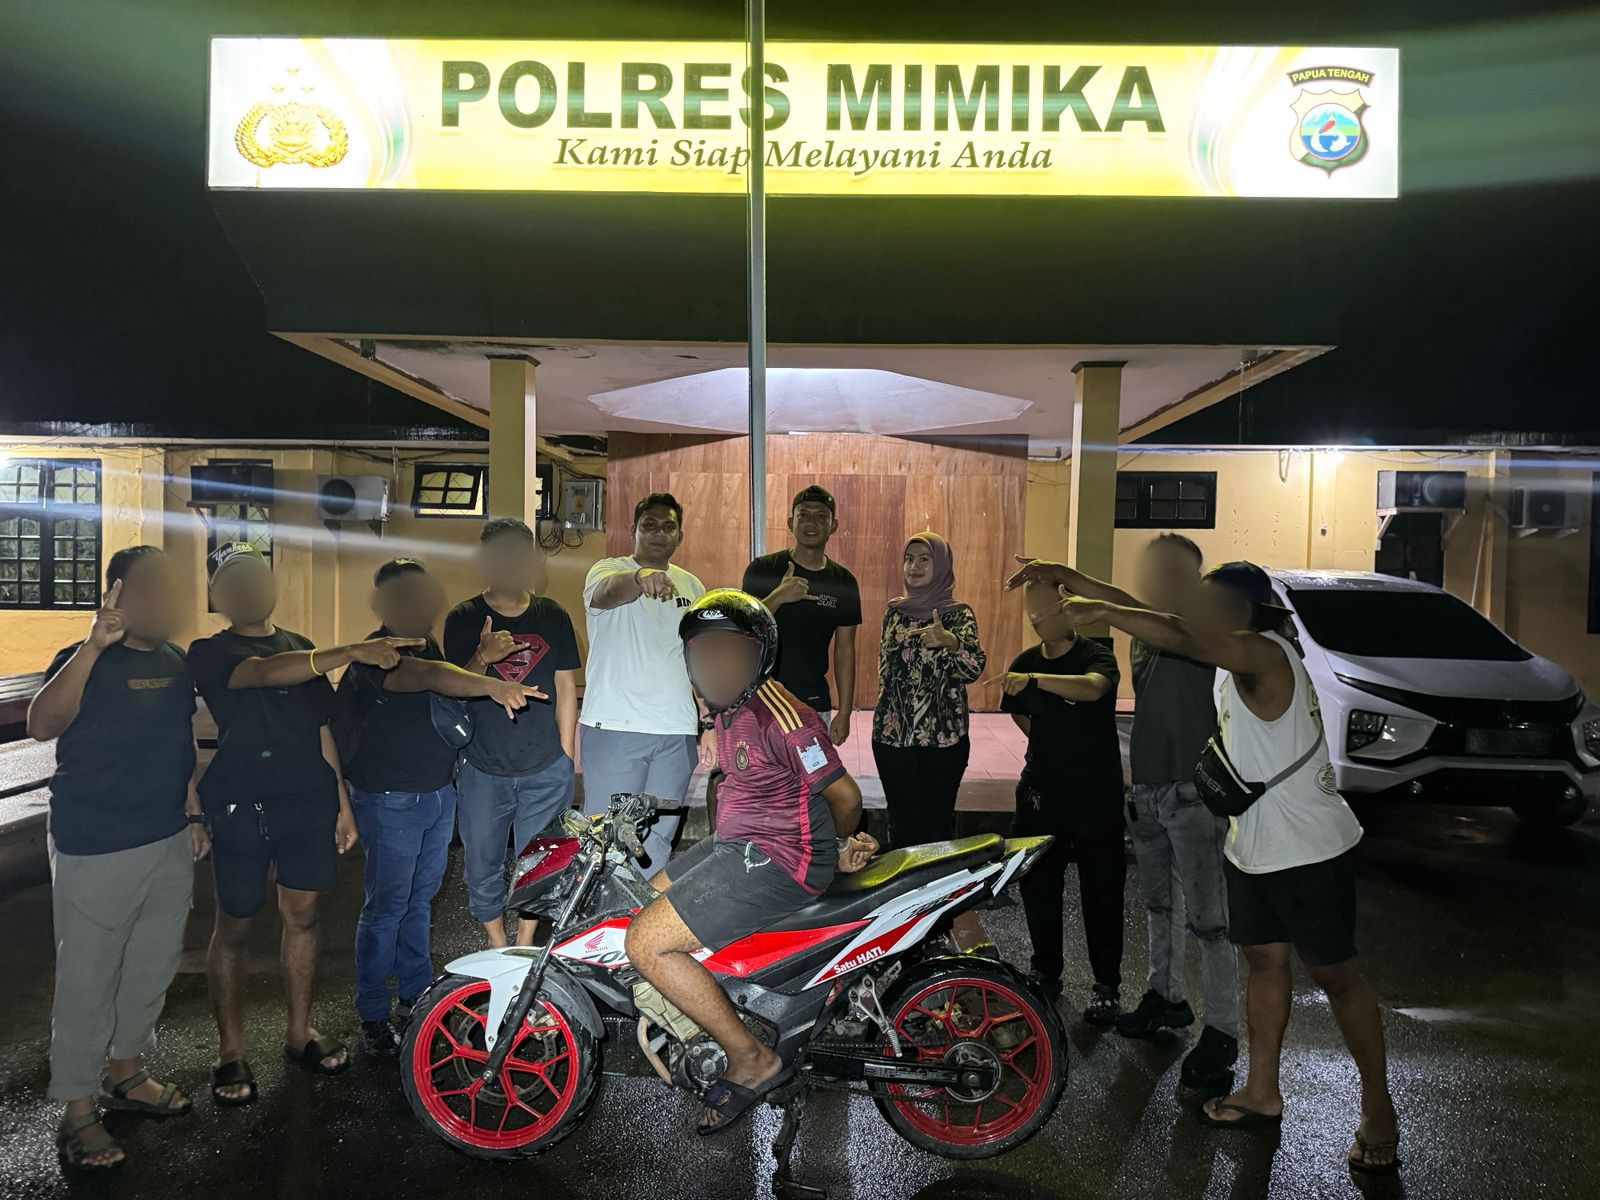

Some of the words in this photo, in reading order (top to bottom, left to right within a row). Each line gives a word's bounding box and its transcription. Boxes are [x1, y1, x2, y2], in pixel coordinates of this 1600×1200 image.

[1292, 68, 1327, 83] PAPUA
[1327, 68, 1370, 83] TENGAH
[441, 60, 790, 131] POLRES
[826, 63, 1166, 133] MIMIKA
[553, 138, 658, 166] Kami
[670, 139, 751, 175] Siap
[764, 140, 941, 176] Melayani
[950, 141, 1053, 169] Anda
[212, 542, 253, 567] Yankees
[833, 959, 857, 974] Satu
